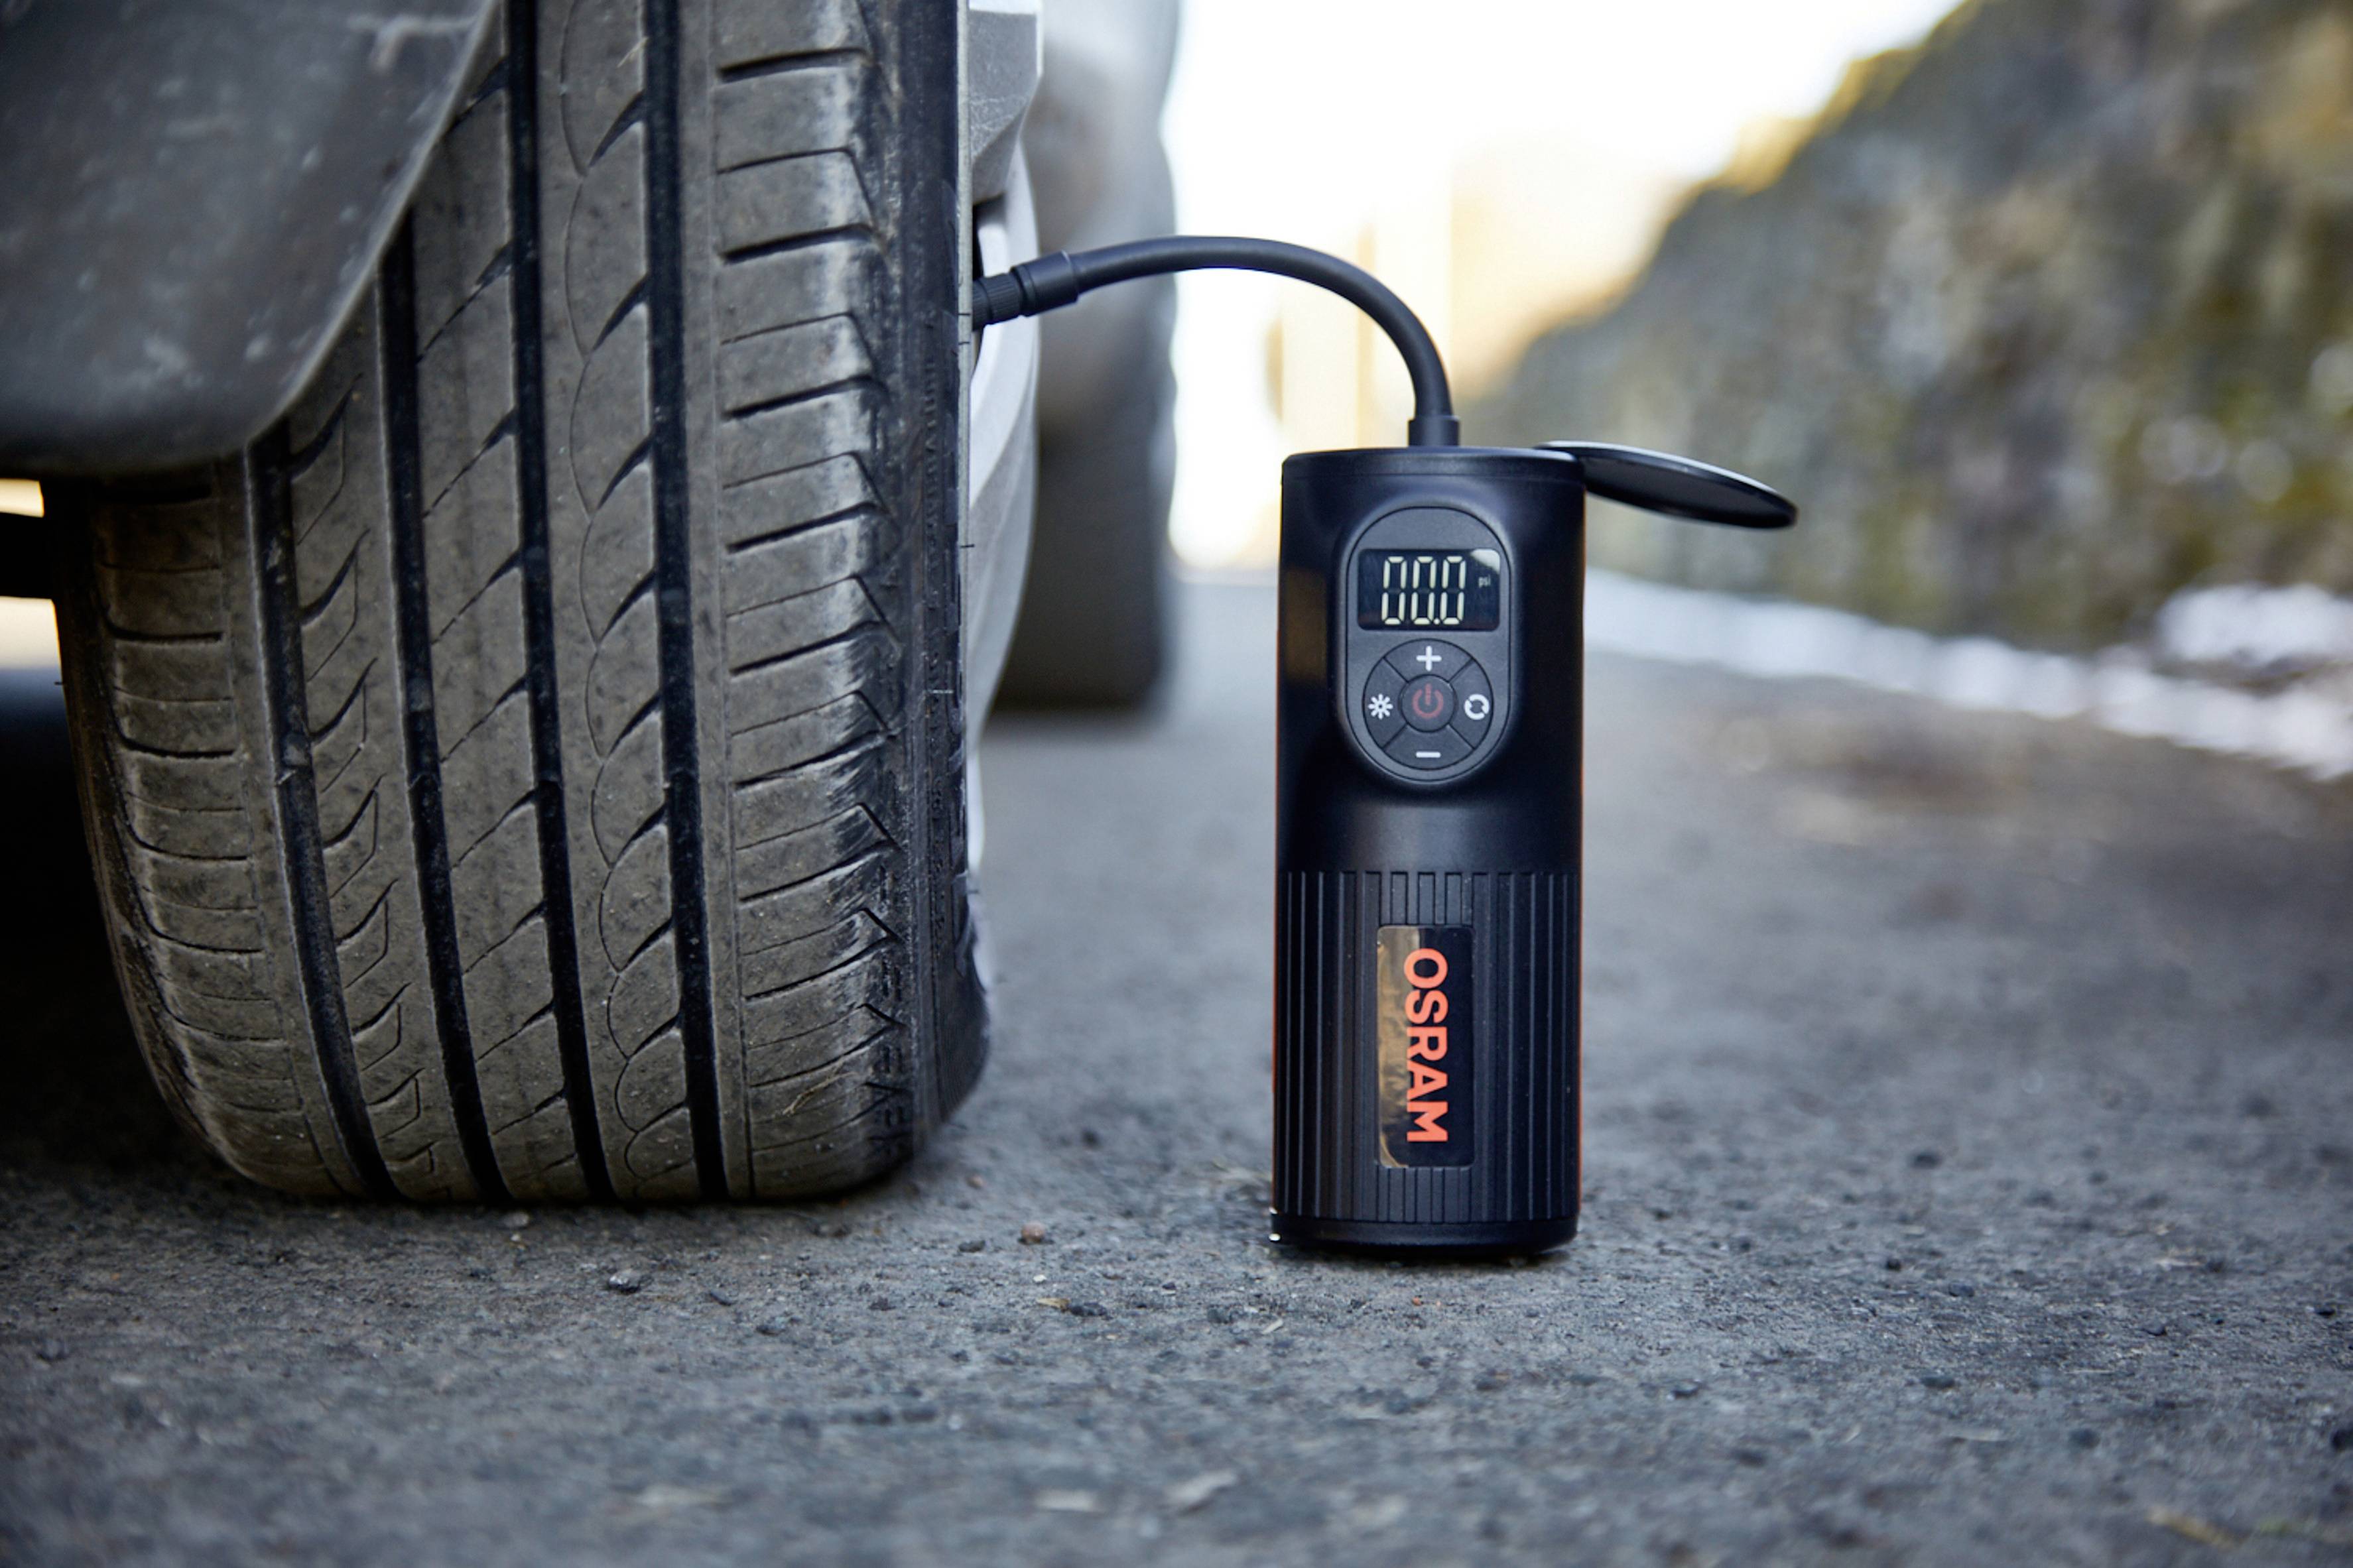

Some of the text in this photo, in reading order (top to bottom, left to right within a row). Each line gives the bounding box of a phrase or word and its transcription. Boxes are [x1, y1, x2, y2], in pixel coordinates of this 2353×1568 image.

[1381, 556, 1491, 625] 00.0 psi
[1404, 948, 1448, 1142] OSRAM
